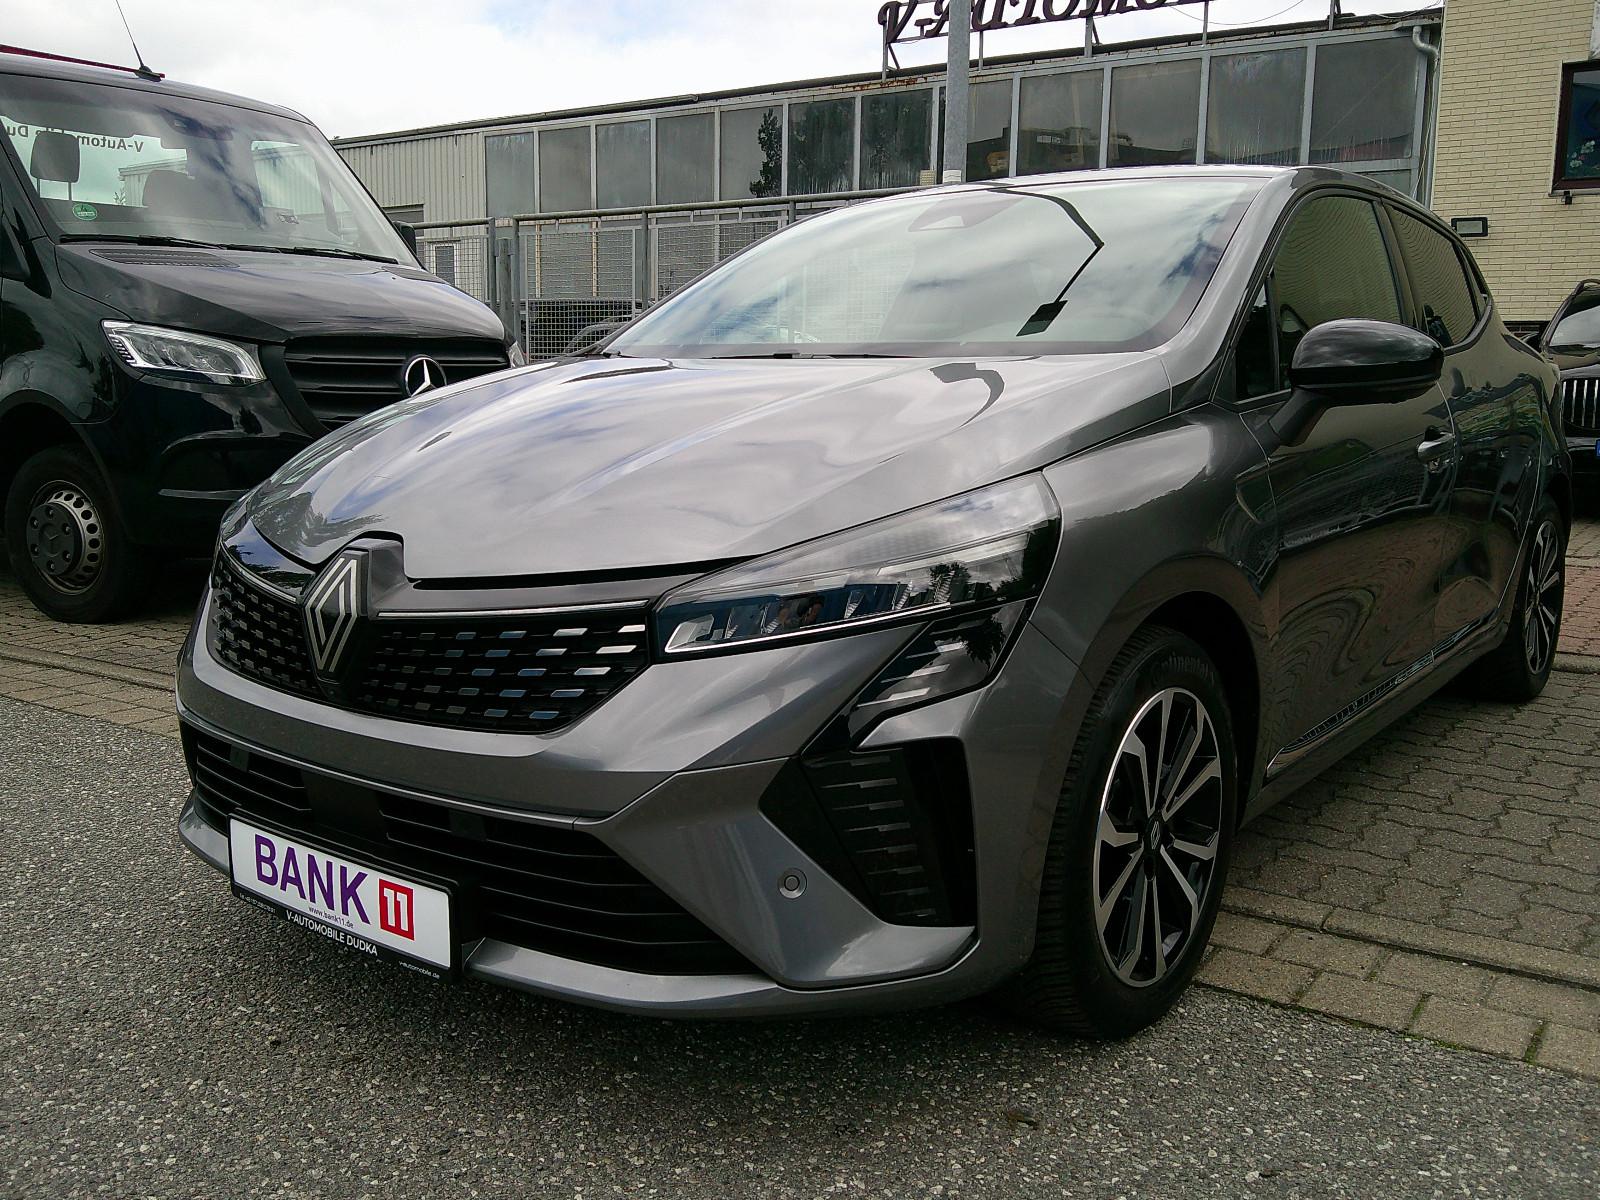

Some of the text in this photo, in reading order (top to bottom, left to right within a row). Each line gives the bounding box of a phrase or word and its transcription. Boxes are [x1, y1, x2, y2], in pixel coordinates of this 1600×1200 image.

[255, 833, 410, 934] BANK 11
[286, 910, 378, 957] V-AUTOMOBILE DUDKA
[308, 905, 354, 929] www.bank11.de
